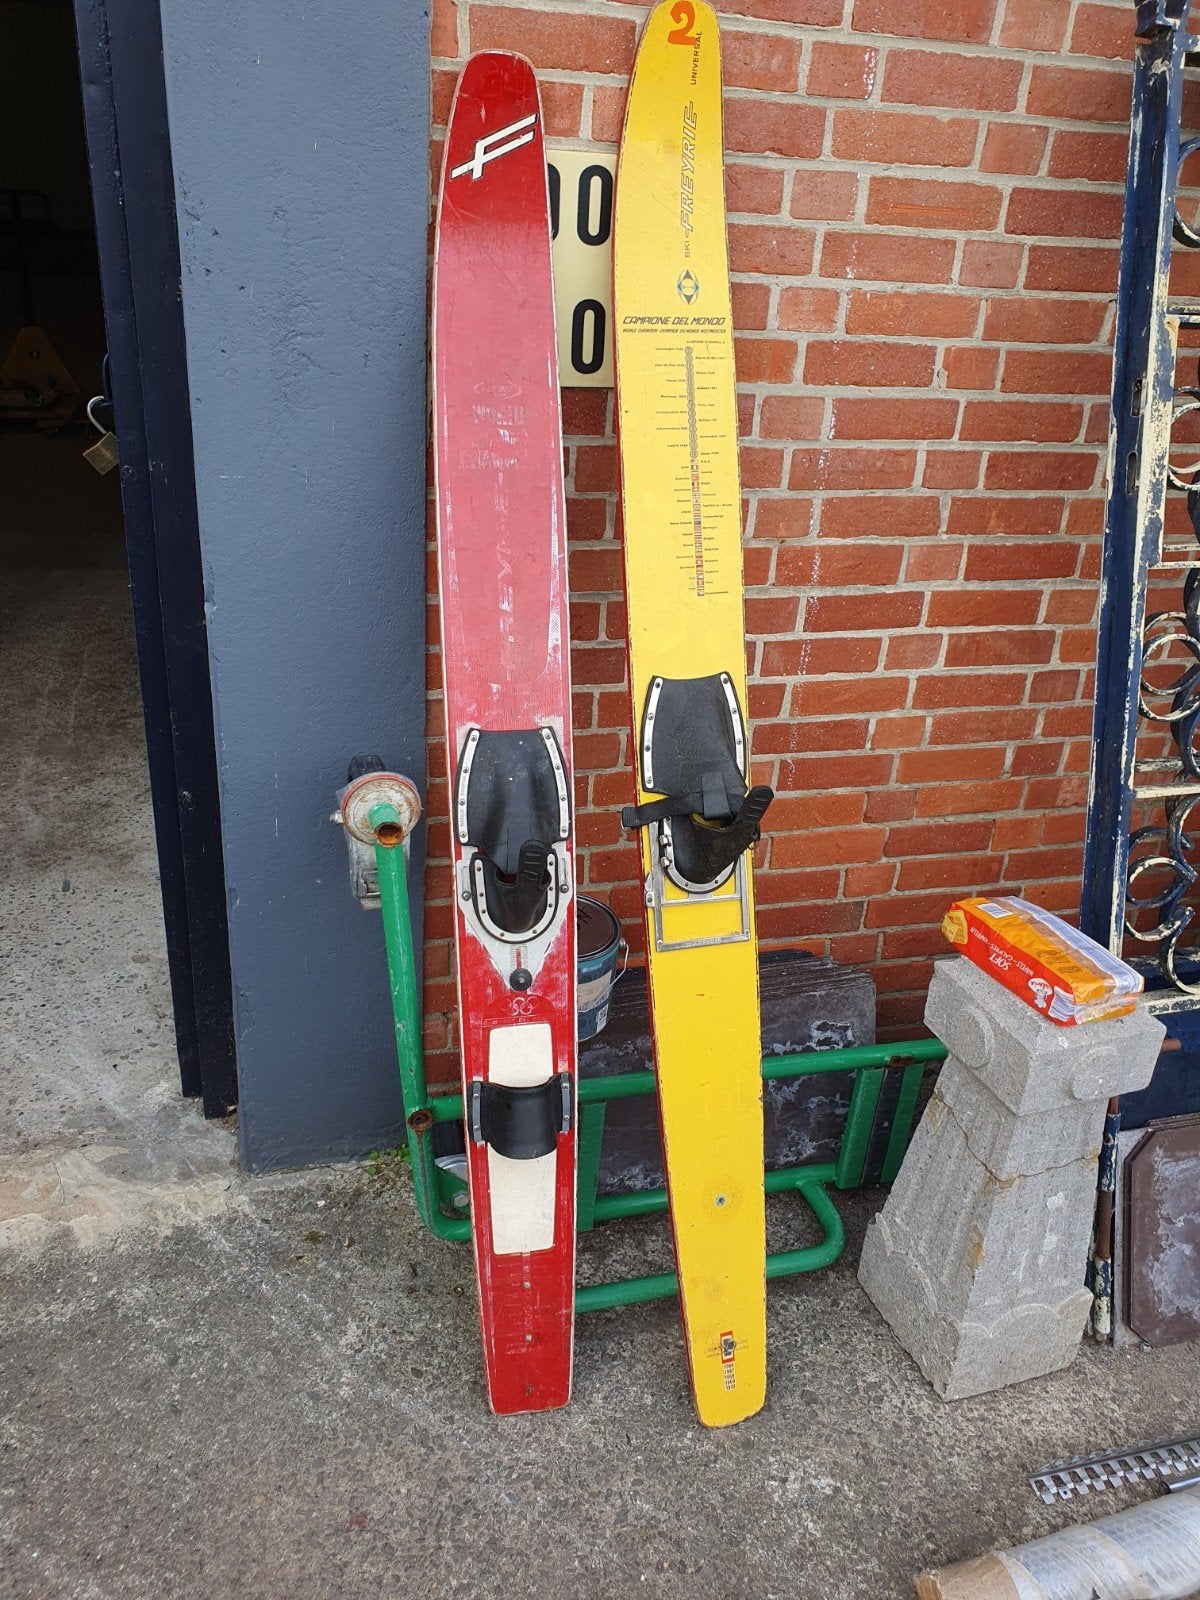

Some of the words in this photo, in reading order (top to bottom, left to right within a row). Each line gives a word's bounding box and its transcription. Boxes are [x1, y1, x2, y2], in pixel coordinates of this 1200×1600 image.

[667, 0, 696, 46] 2
[691, 31, 702, 86] UNIVERSAL
[680, 100, 697, 238] FREYRIE
[622, 316, 670, 325] CAMPIONE
[671, 316, 690, 325] DEL
[690, 317, 726, 325] MONDO
[989, 952, 1012, 971] SOFT
